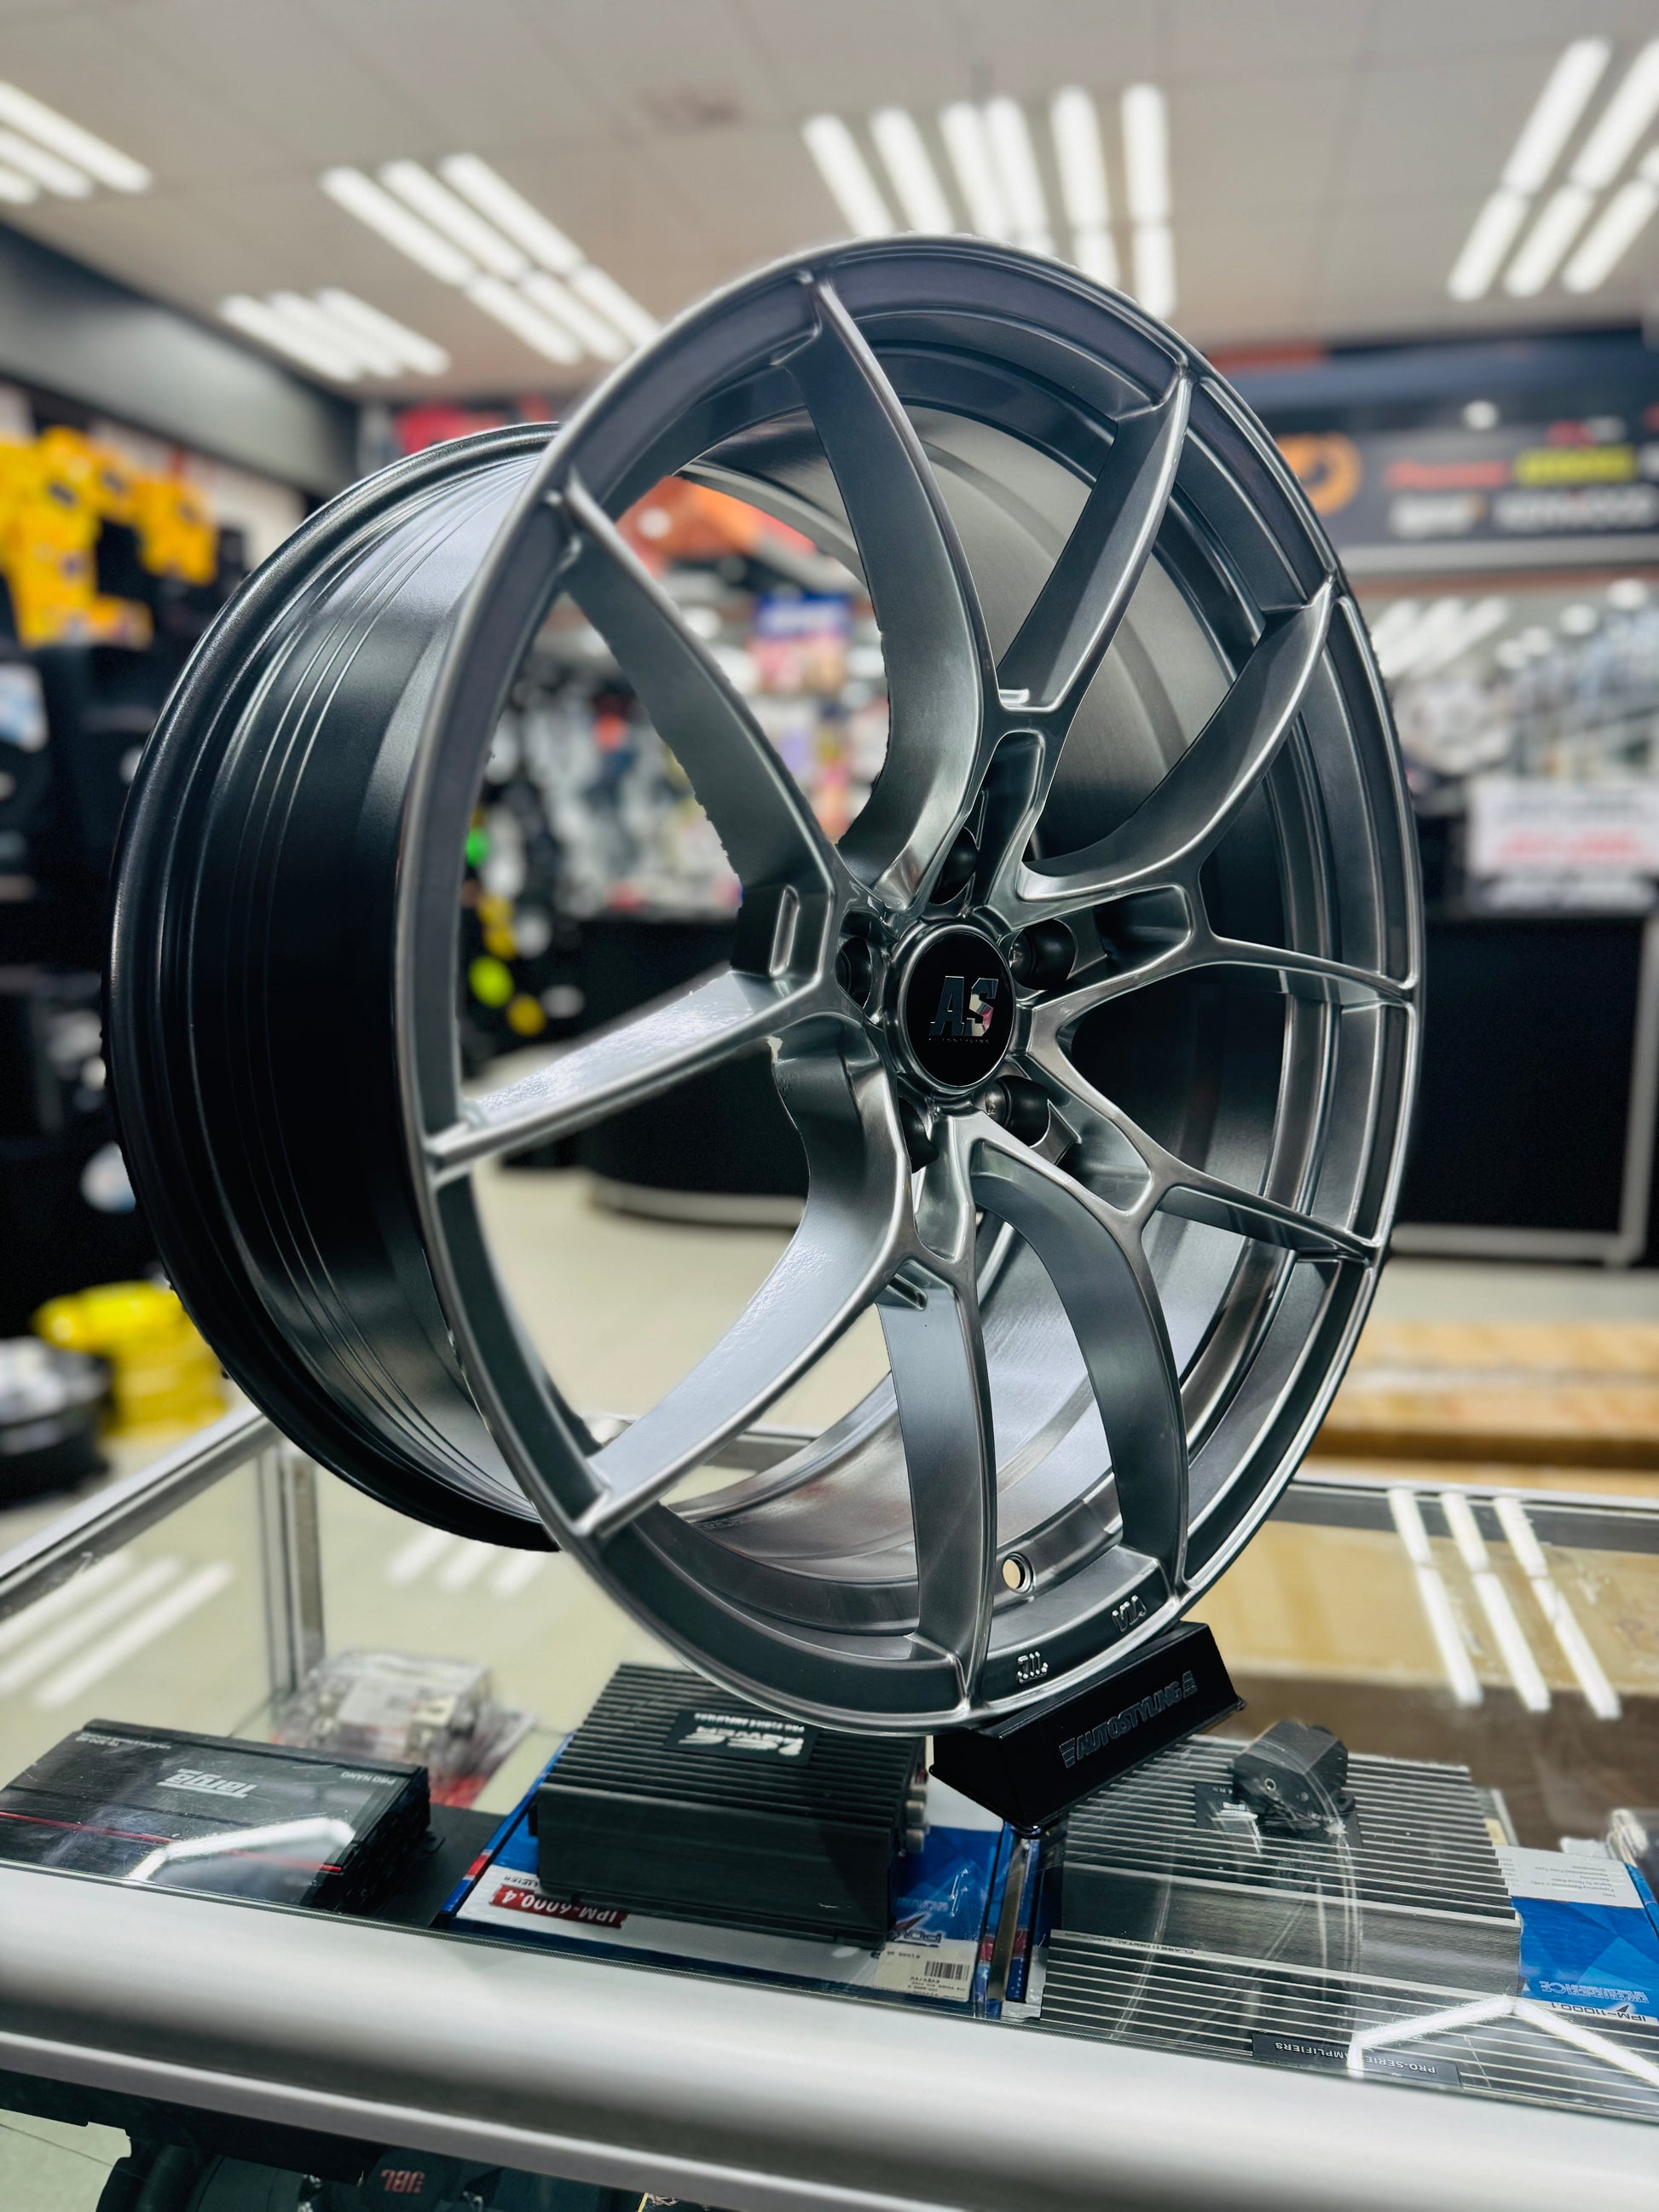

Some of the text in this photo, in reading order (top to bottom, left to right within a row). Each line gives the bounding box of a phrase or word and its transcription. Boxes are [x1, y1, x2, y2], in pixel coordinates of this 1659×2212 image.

[928, 976, 998, 1037] AS
[1077, 1681, 1182, 1760] AUTOSTYLING
[157, 1768, 257, 1799] Targa
[1552, 2001, 1648, 2022] IPM-11000.1
[1363, 2056, 1436, 2074] PRO-SERIE
[381, 2169, 425, 2194] JBL
